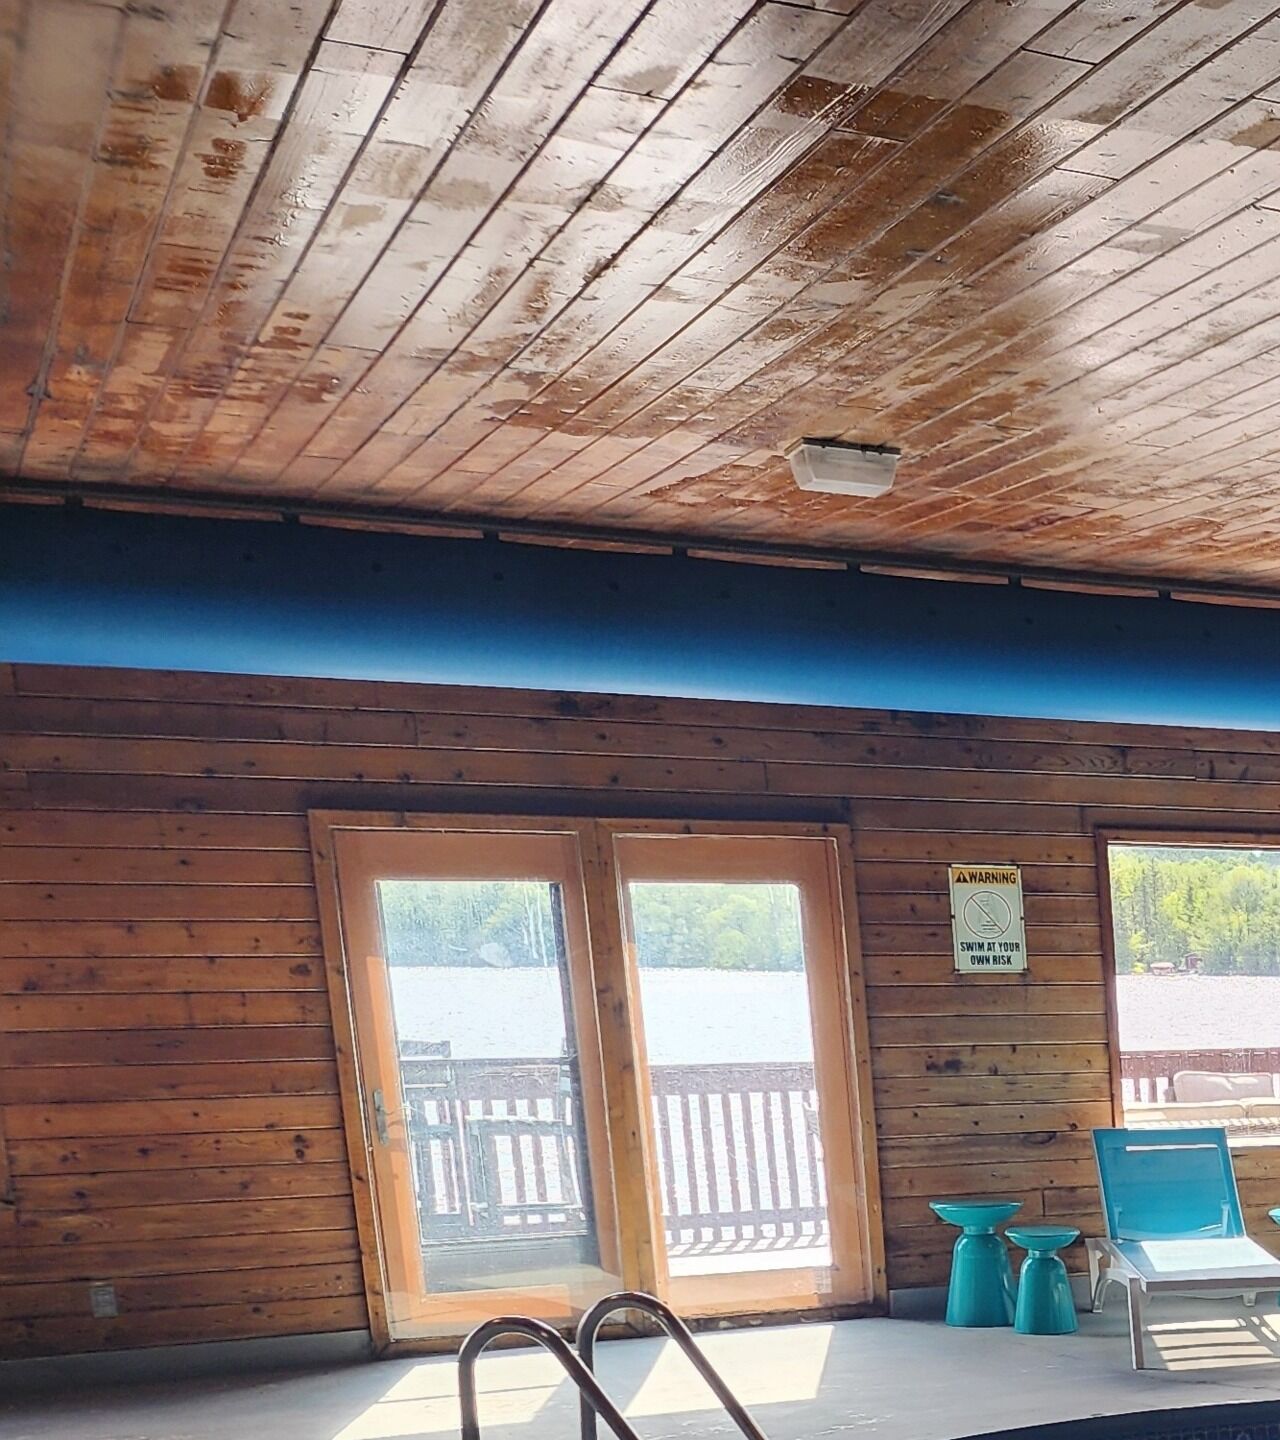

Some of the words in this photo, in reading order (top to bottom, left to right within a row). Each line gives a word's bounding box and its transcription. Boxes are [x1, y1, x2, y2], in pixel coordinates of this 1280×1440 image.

[968, 871, 1016, 884] WARNING
[960, 941, 985, 952] SWIM
[987, 942, 997, 953] AT
[998, 942, 1020, 953] YOUR
[970, 955, 991, 966] OWN
[992, 955, 1012, 966] RISK
